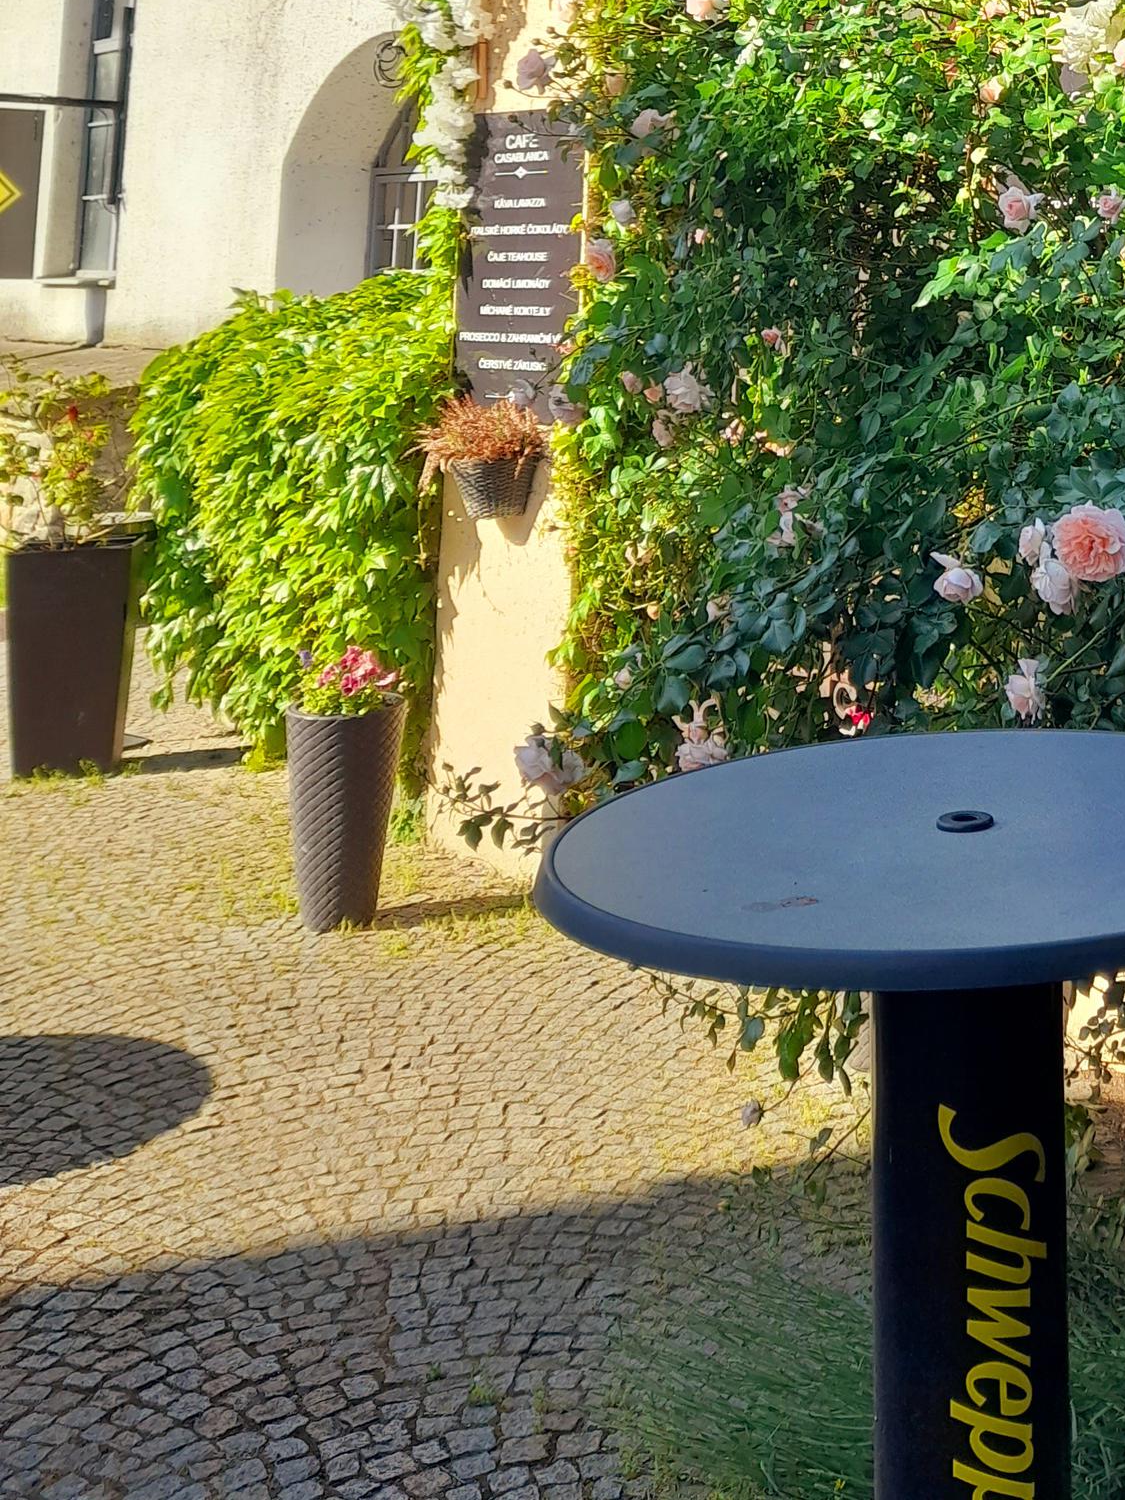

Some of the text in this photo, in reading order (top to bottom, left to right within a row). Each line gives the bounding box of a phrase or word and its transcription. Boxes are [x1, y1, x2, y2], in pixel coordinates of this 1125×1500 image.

[494, 150, 549, 164] CASABLANCA
[513, 197, 546, 208] LAVAZZA
[482, 277, 551, 289] DOMÁCÍ LIMONÁDY
[480, 304, 552, 317] MÍCHANÉ KOKTEJLY
[459, 332, 500, 342] PROSECCO
[507, 332, 552, 344] ZAHRANIČNÍ
[478, 358, 512, 370] ČERSTVÉ
